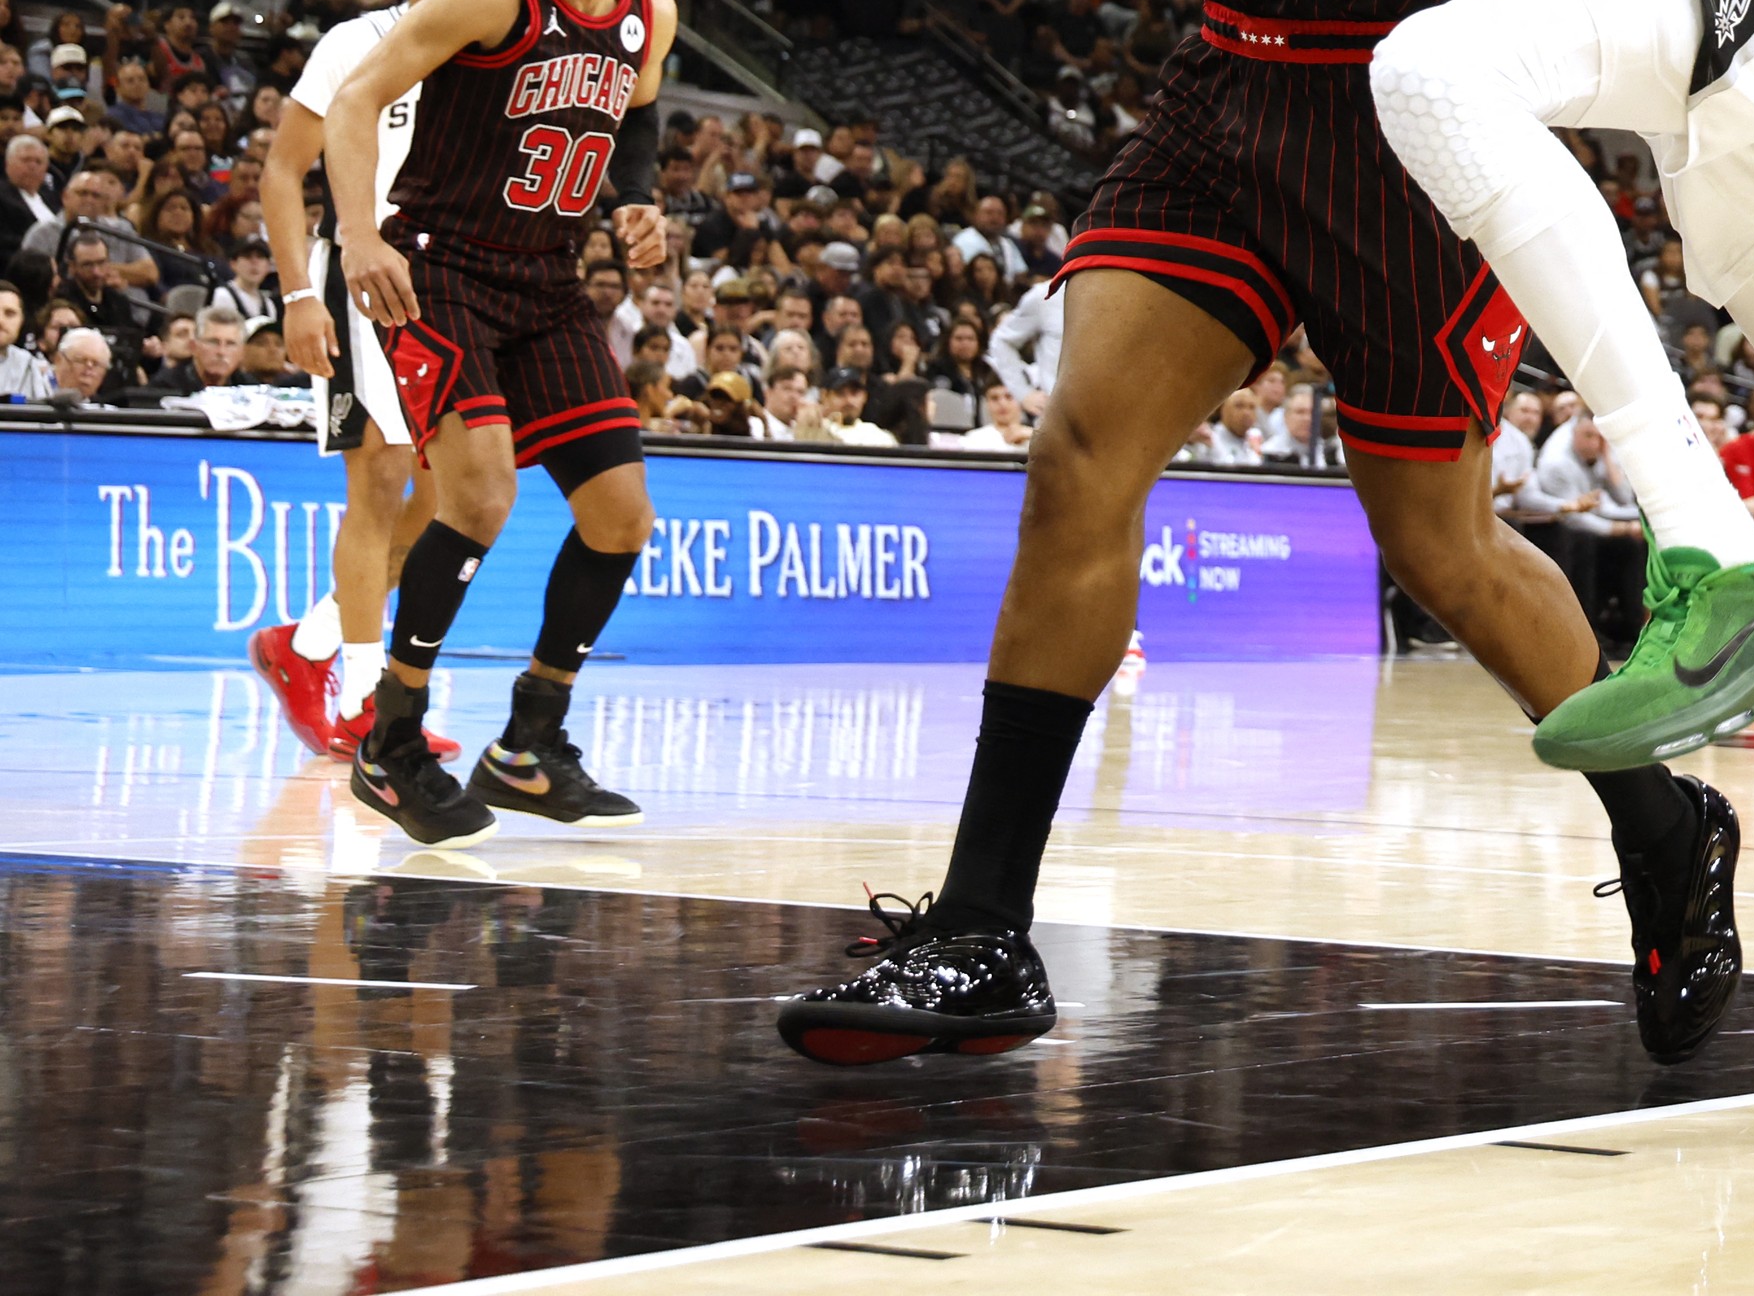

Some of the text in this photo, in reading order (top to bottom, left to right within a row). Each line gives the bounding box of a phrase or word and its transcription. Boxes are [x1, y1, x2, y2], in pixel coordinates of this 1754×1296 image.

[504, 53, 640, 129] CHICAG
[503, 124, 616, 217] 30
[98, 484, 196, 578] The
[747, 510, 930, 600] PALMER
[1198, 530, 1293, 560] STREAMING
[1198, 566, 1242, 592] NOW
